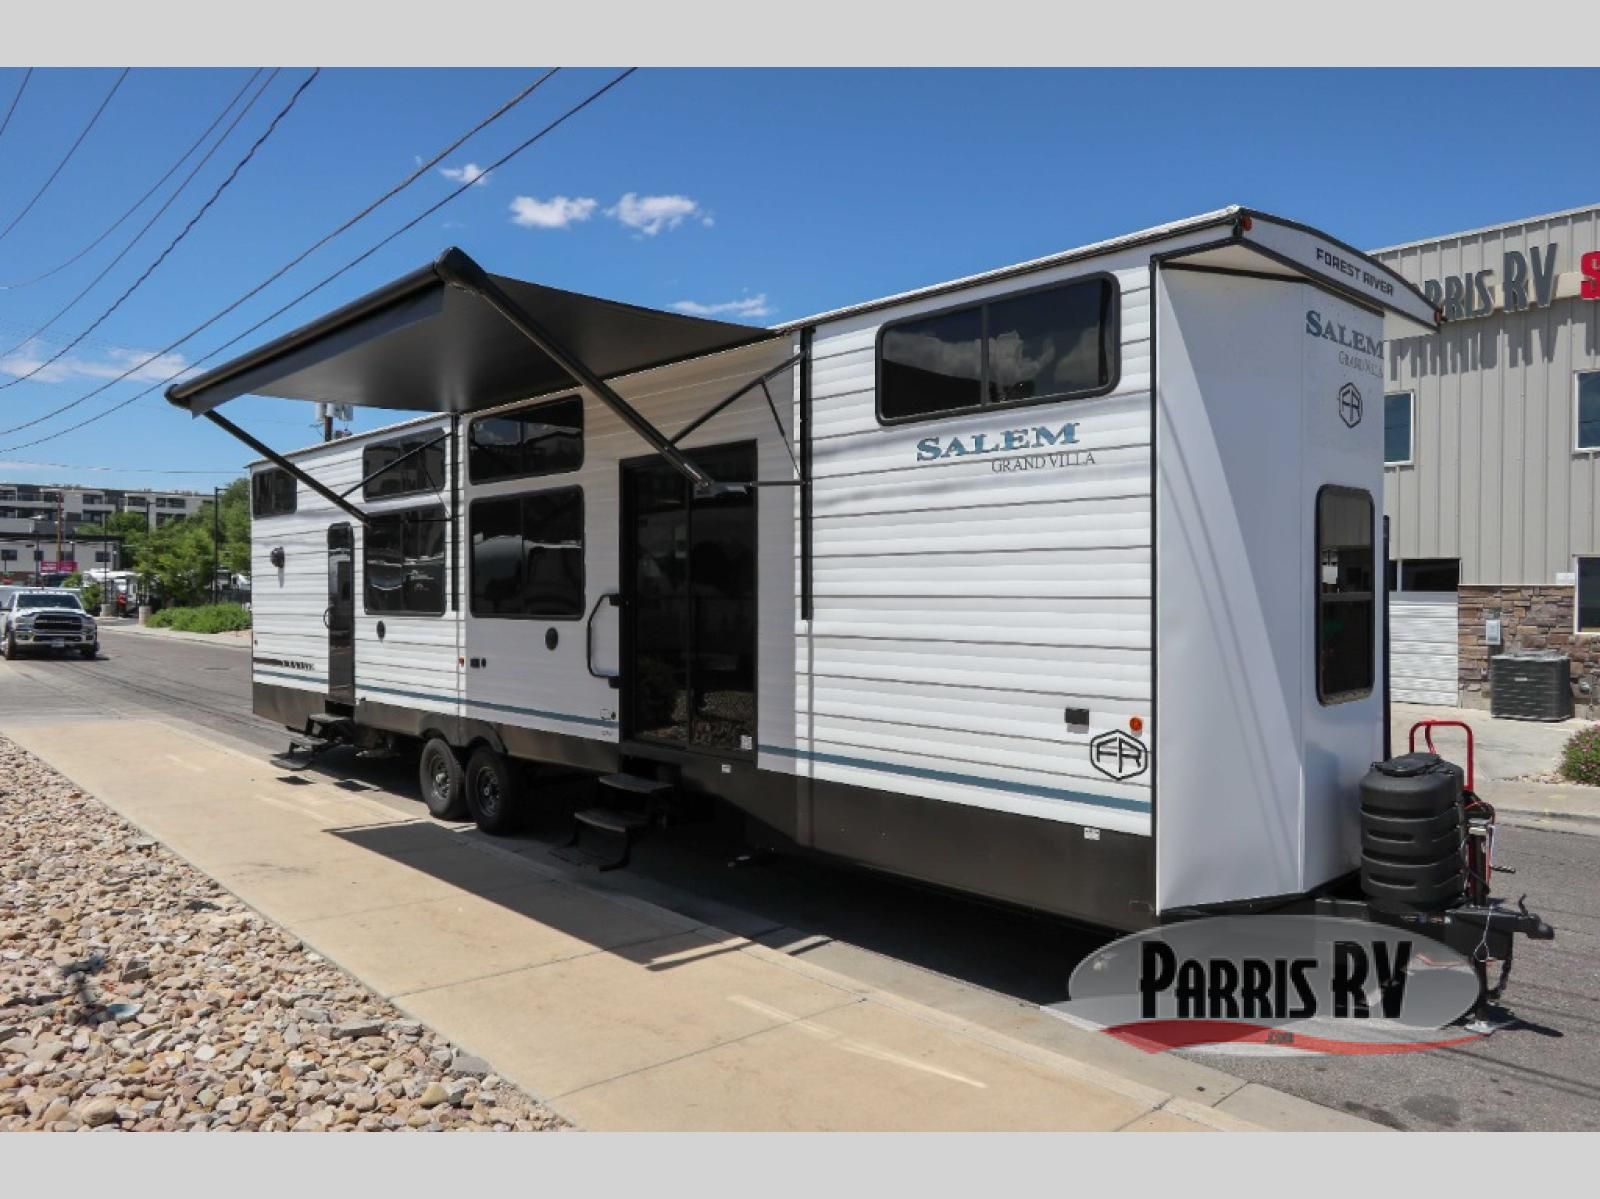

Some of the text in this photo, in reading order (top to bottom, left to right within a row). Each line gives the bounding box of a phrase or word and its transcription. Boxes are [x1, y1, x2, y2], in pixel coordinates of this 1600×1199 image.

[1316, 247, 1393, 296] FOREST RIVER
[1502, 243, 1558, 312] RV
[1305, 310, 1384, 360] SALEM
[916, 422, 1080, 462] SALEM
[991, 451, 1096, 473] GRAND VILLA
